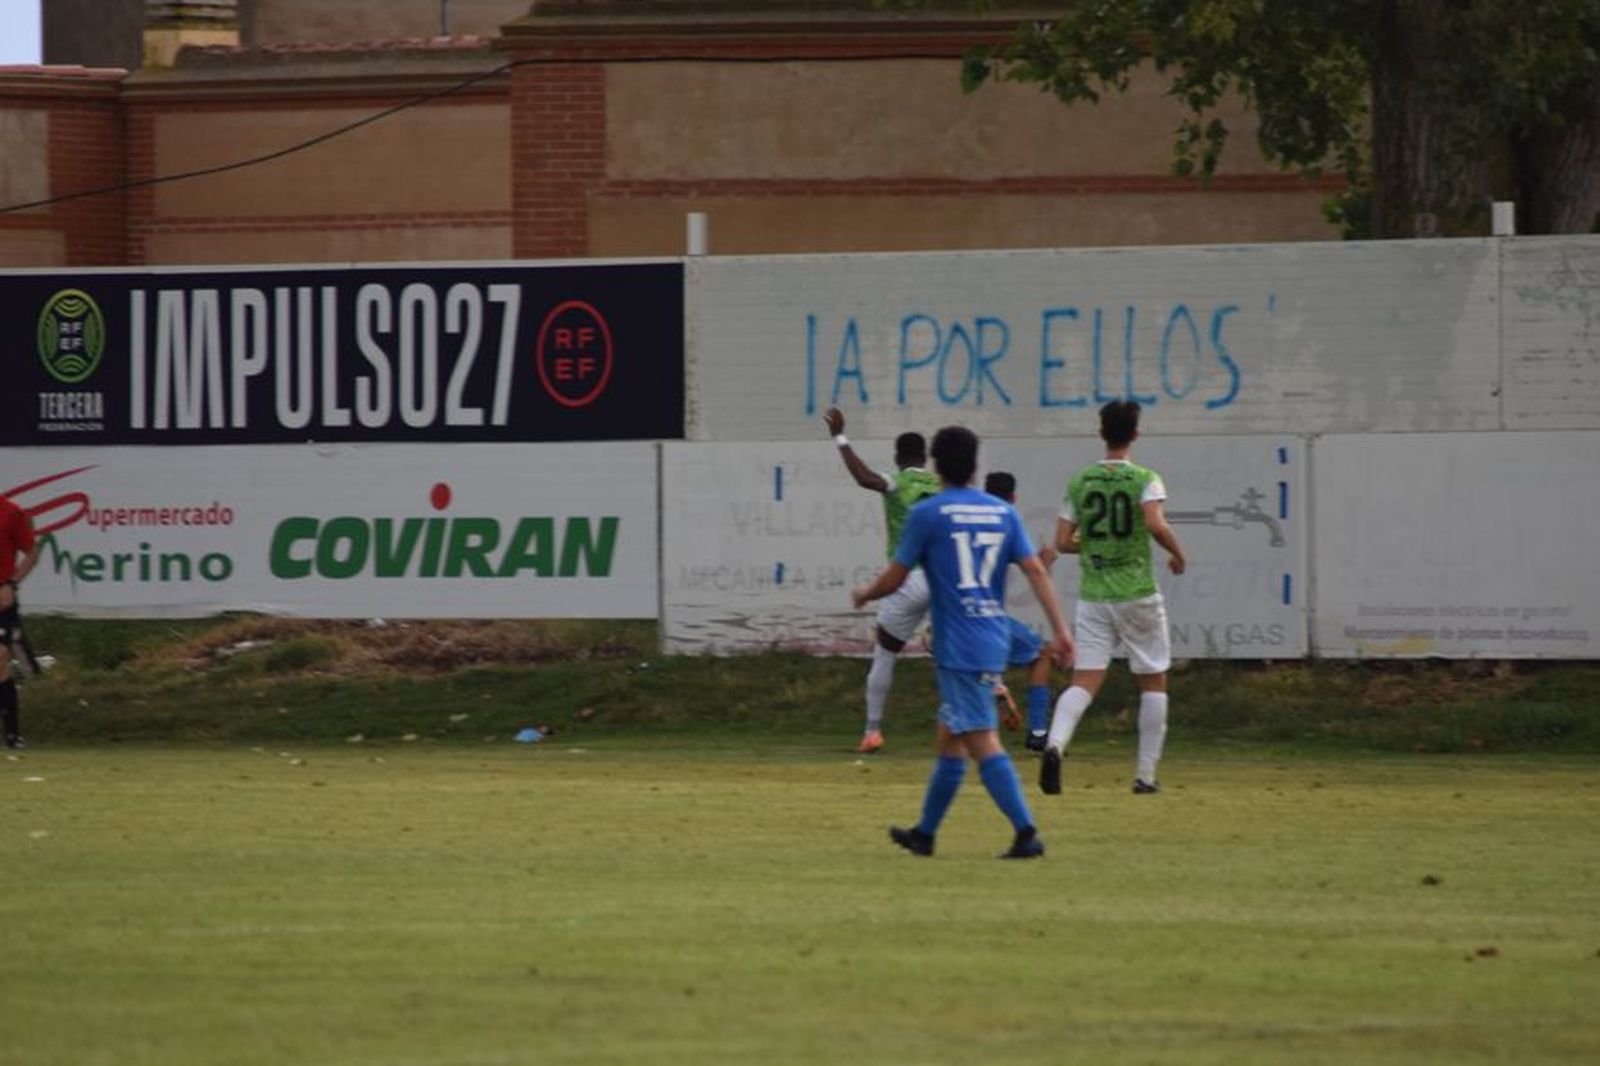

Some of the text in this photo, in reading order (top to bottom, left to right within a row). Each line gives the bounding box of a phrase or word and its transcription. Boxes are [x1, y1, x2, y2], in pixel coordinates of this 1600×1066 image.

[129, 283, 521, 429] IMPULSO27
[554, 328, 596, 350] RF
[898, 313, 1011, 405] POR
[1038, 304, 1240, 409] ELLOS
[554, 358, 596, 379] EF
[269, 482, 620, 580] COVIRAN
[1083, 490, 1133, 538] 20
[951, 531, 1006, 589] 17
[1225, 623, 1286, 646] GAS
